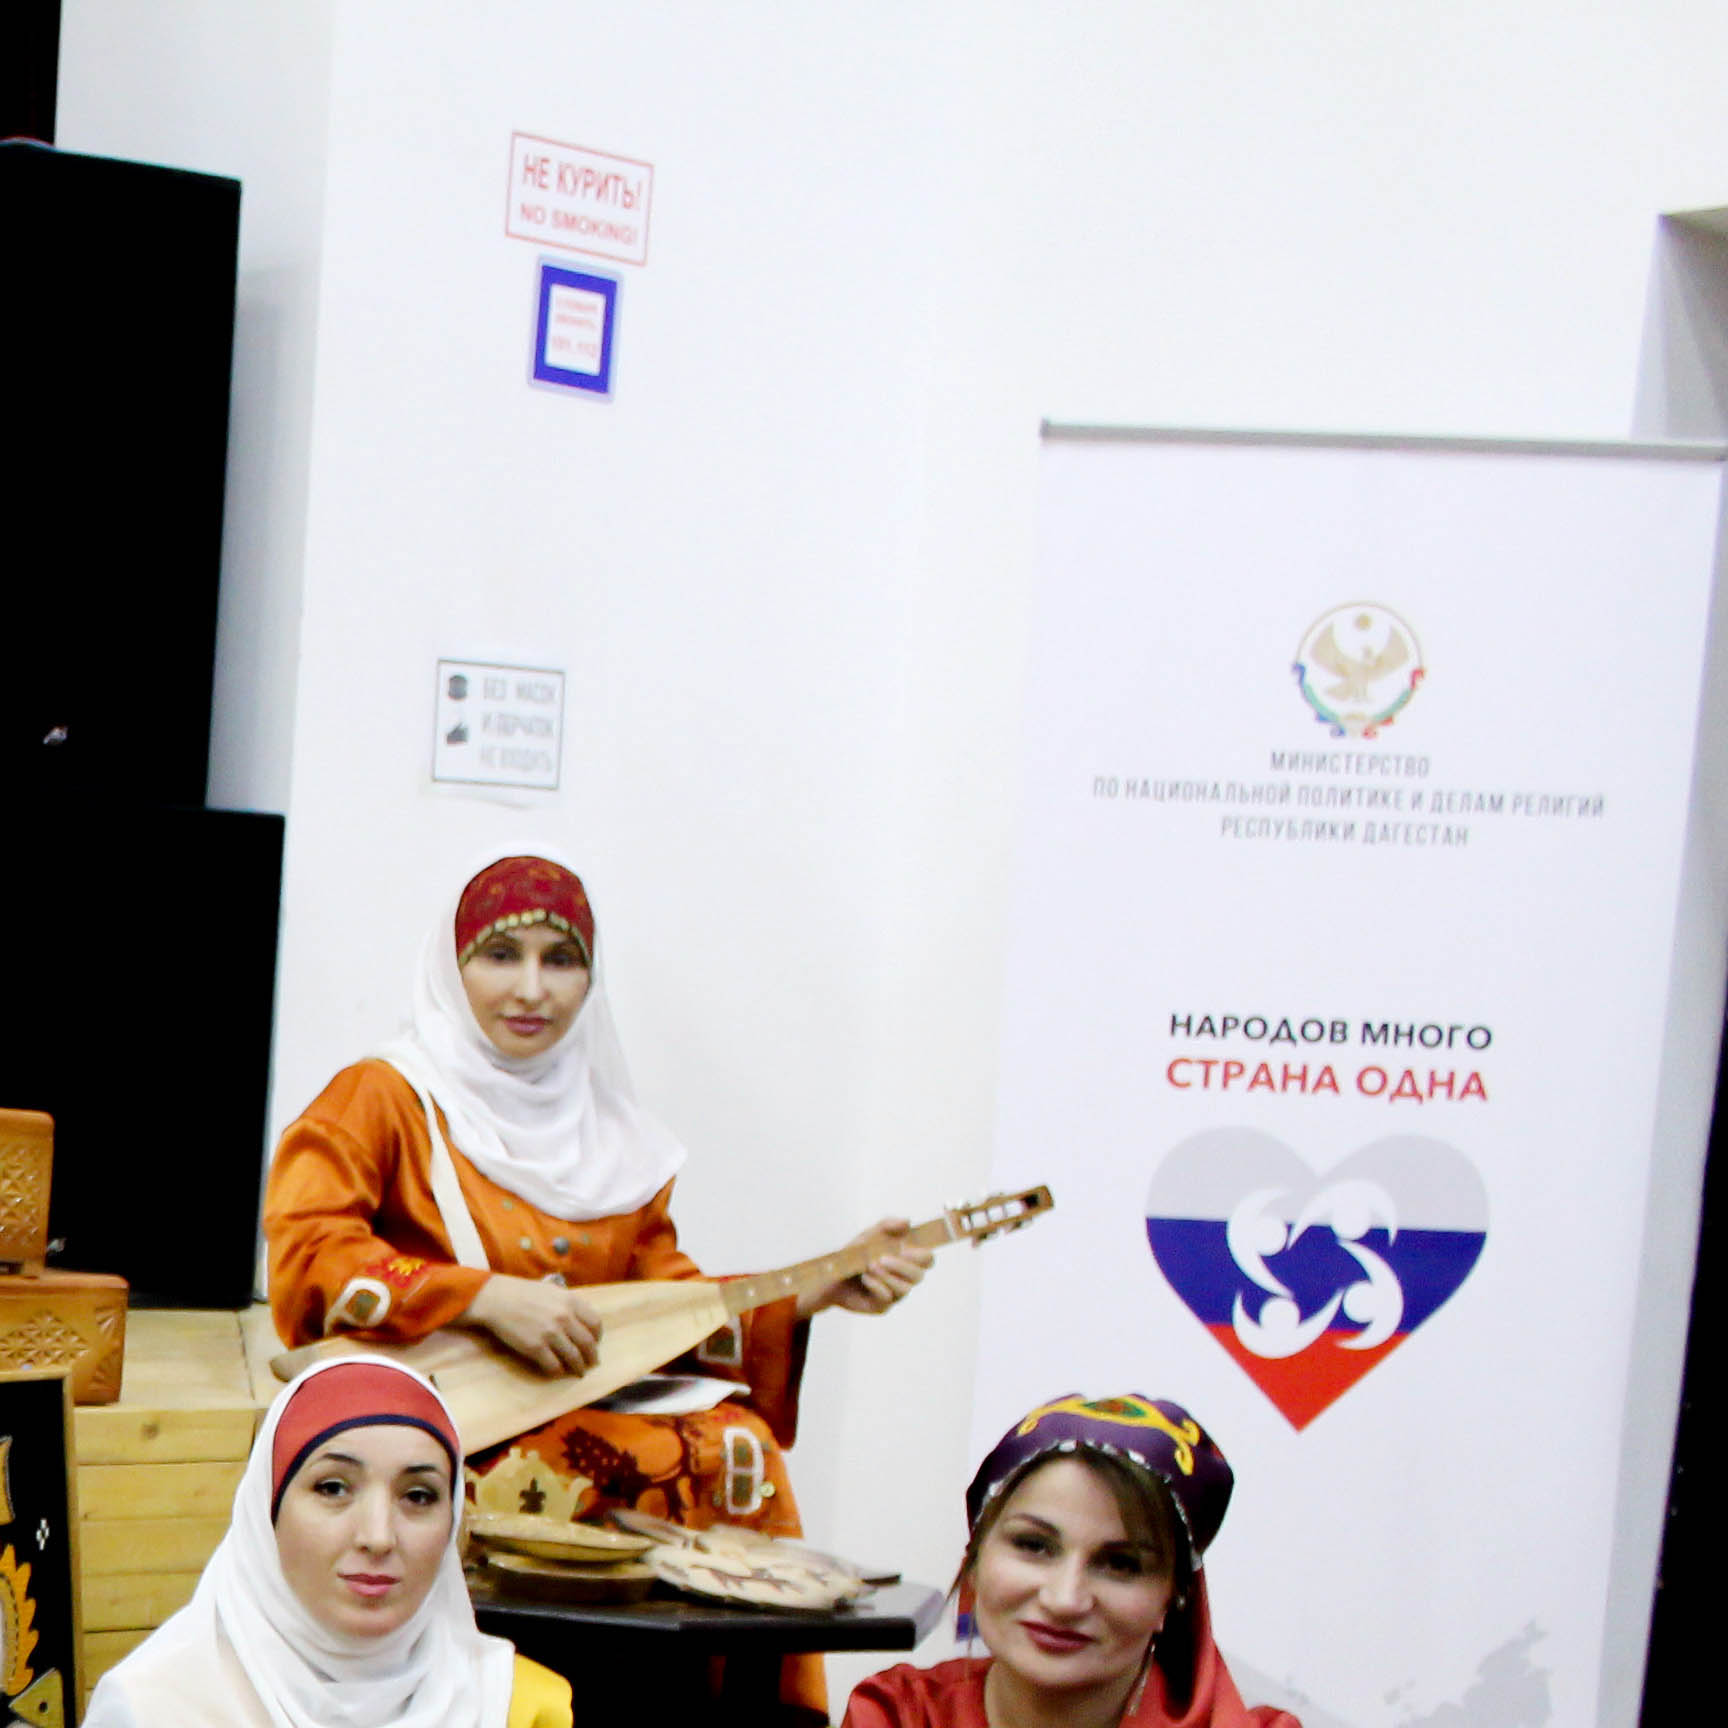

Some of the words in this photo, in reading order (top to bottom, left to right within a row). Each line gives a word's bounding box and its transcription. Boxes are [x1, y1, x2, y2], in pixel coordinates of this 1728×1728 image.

[522, 153, 550, 190] НЕ
[520, 203, 547, 225] NO
[1270, 751, 1430, 777] МИНИСТЕРСТВО
[1093, 776, 1119, 798] ПО
[1126, 778, 1291, 805] НАЦИОНАЛЬНОЙ
[1297, 784, 1401, 811] ПОЛИТИКЕ
[1411, 791, 1423, 811] И
[1430, 789, 1504, 815] ДЕЛАМ
[1512, 793, 1605, 818] РЕЛИГИЙ
[1221, 815, 1355, 842] РЕСПУБЛИКИ
[1363, 821, 1469, 847] ДАГЕСТАН
[1169, 1014, 1348, 1045] НАРОДОВ
[1361, 1023, 1493, 1050] МНОГО
[1166, 1057, 1340, 1095] СТРАНА
[1356, 1066, 1489, 1104] ОДНА
